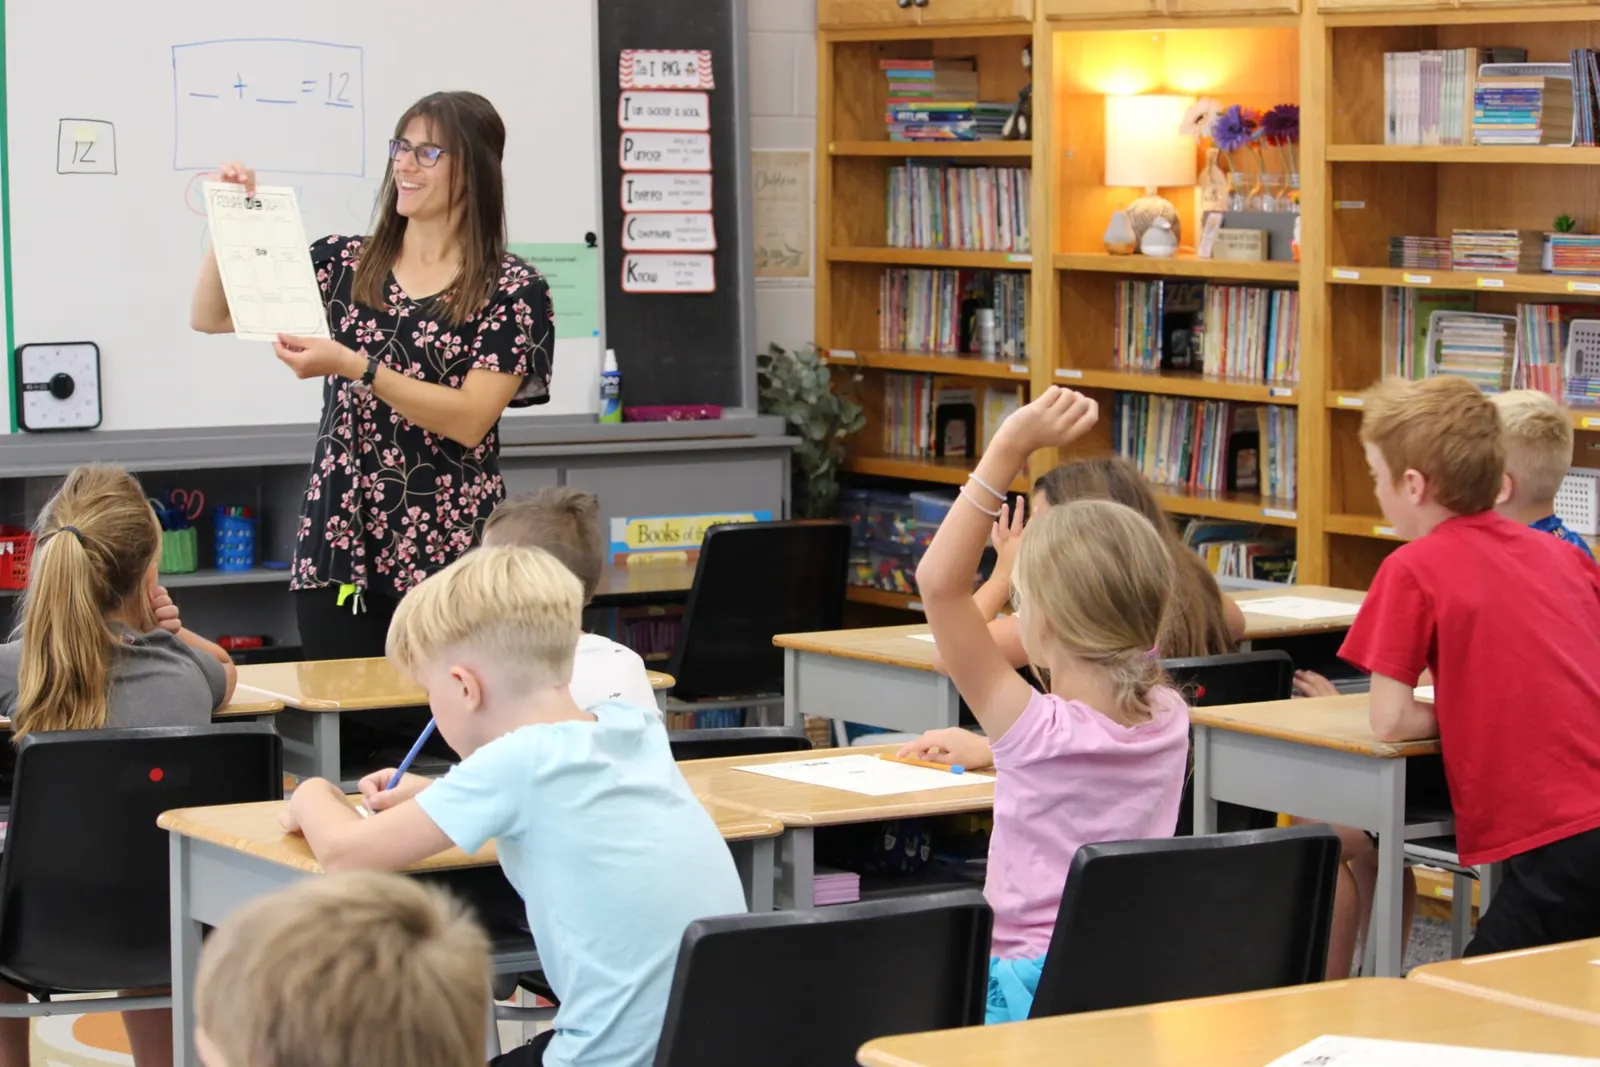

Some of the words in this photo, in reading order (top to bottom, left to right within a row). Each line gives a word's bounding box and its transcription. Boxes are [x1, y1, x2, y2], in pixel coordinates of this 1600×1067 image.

[326, 71, 352, 103] 12
[72, 140, 97, 165] 12
[637, 521, 680, 544] Books
